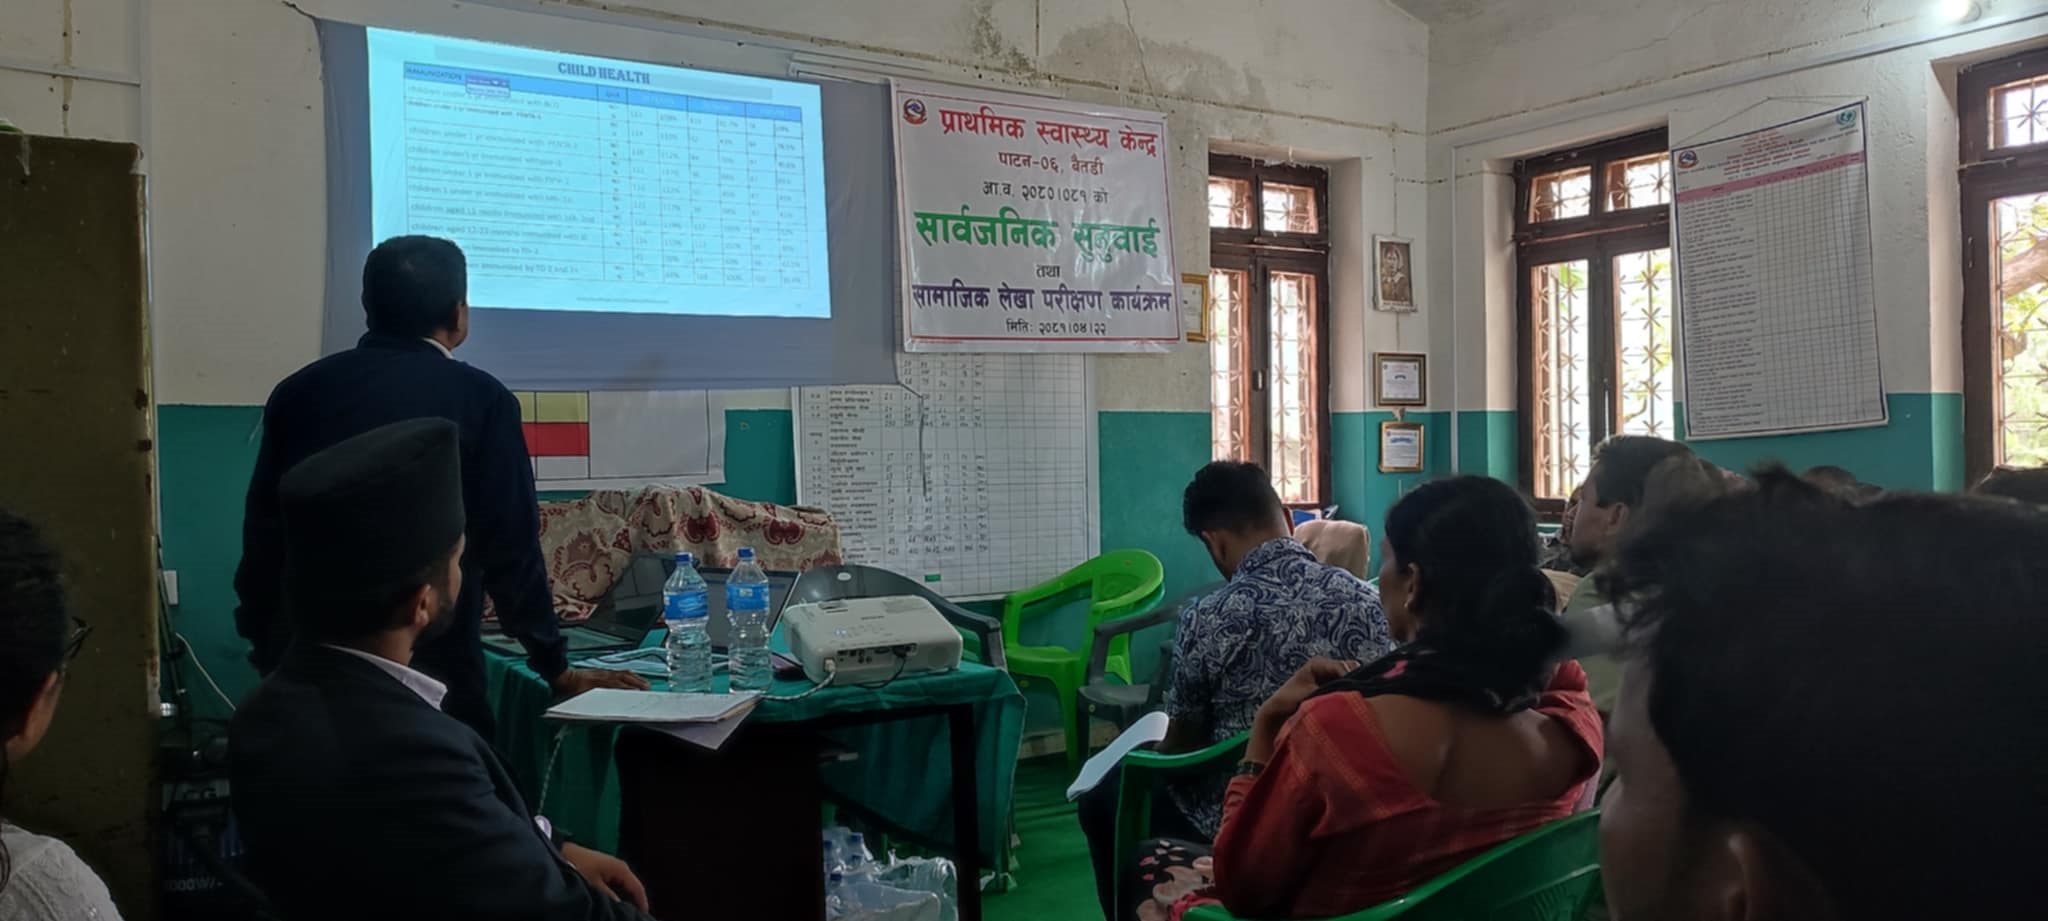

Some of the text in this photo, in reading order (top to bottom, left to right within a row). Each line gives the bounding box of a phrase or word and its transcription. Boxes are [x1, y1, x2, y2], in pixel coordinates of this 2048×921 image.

[557, 61, 651, 85] CHILD HEALTH
[939, 106, 1158, 156] प्राथमिक स्वास्थ्य केन्द्र
[1094, 186, 1109, 203] को
[914, 204, 1161, 264] सार्वजनिक सुनुवाई
[1035, 263, 1061, 279] तथा
[911, 277, 1172, 314] सामाजिक लेखा परीक्षण कार्यक्रम
